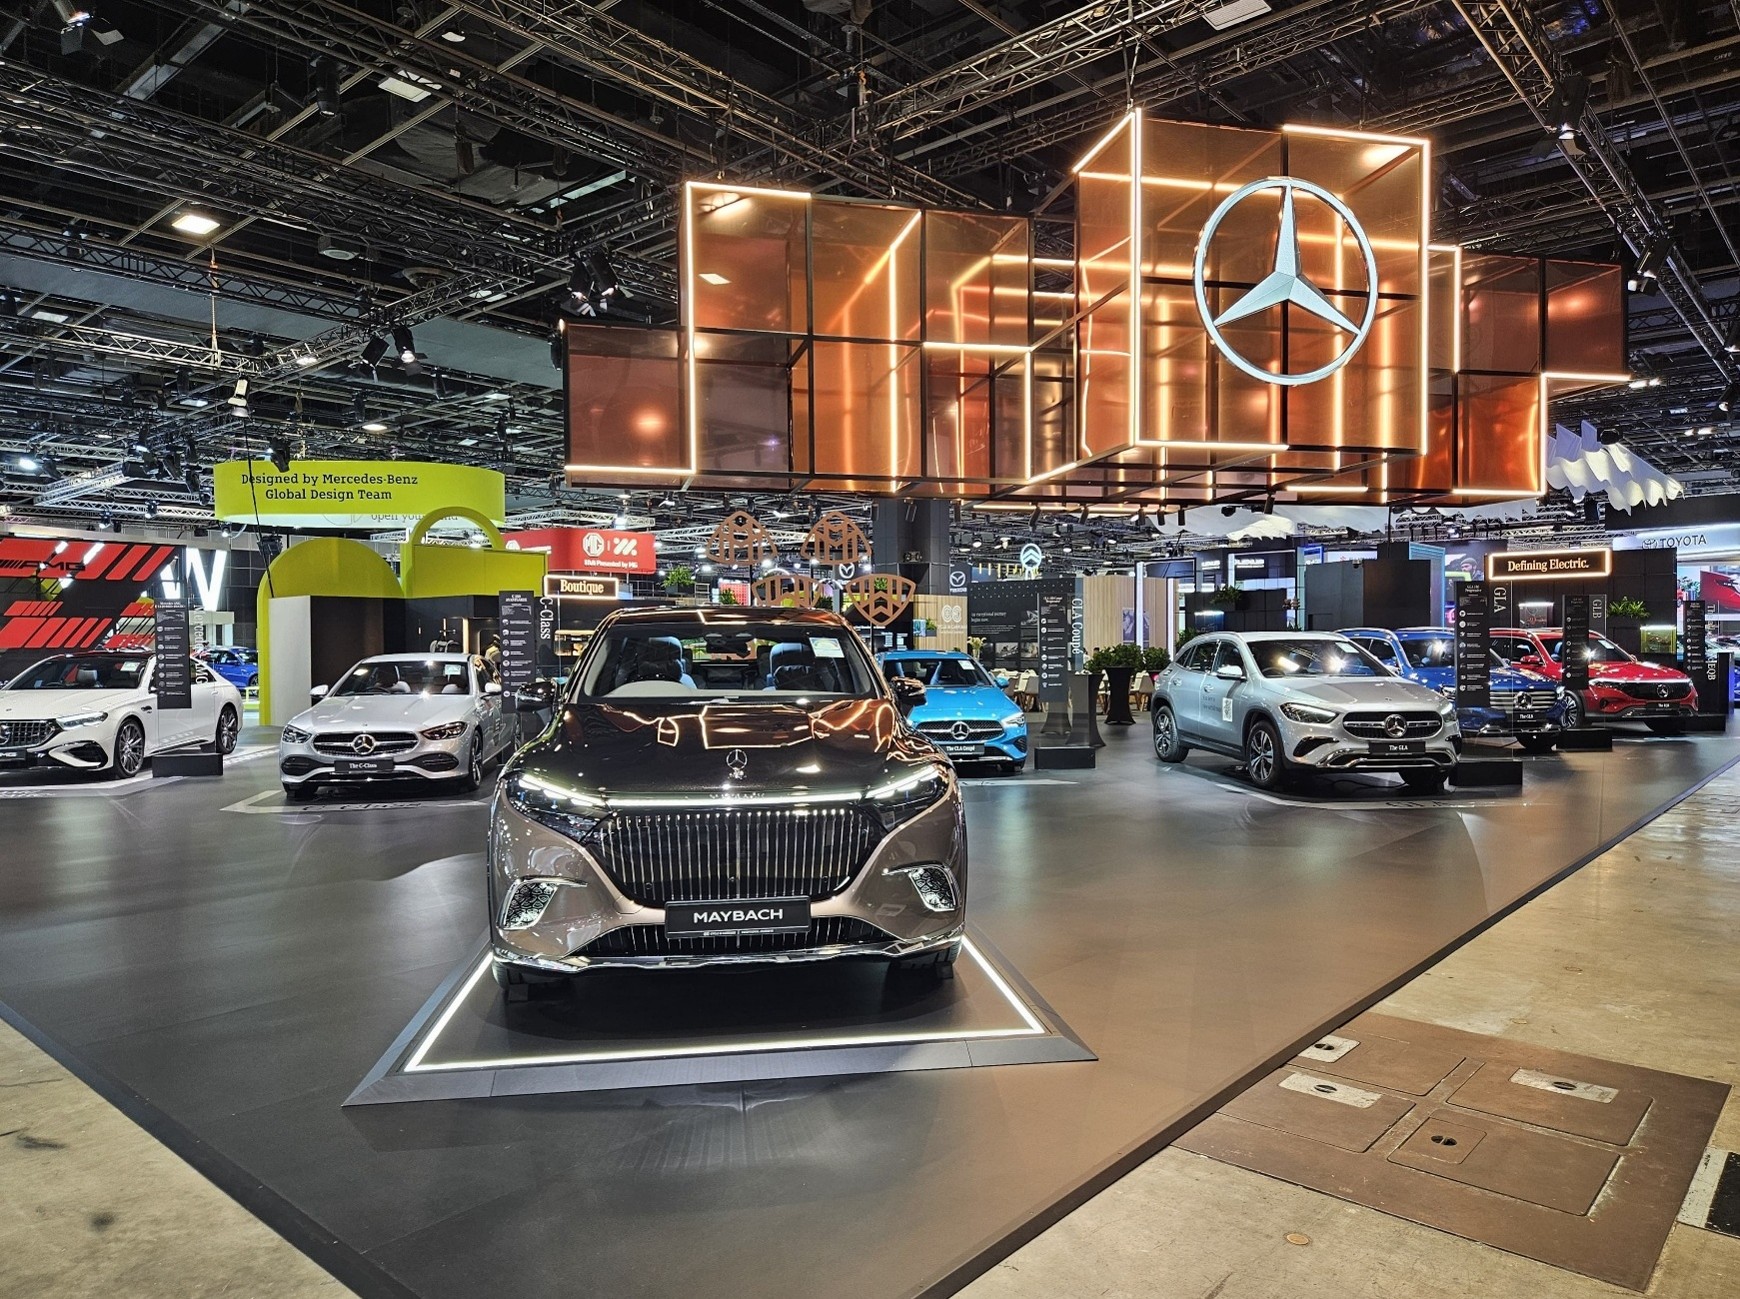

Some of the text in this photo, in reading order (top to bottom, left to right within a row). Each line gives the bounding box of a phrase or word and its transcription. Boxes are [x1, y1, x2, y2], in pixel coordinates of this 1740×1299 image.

[241, 473, 418, 486] Designed by Mercedes-Benz
[265, 488, 392, 502] Global Design Team
[1659, 534, 1707, 549] TOYOTA
[1507, 557, 1590, 573] Defining Electric.
[560, 579, 604, 595] Boutique
[1493, 587, 1507, 613] GLA
[1592, 599, 1603, 619] GLB
[539, 597, 554, 640] C-Class
[1071, 598, 1084, 655] CLA Coupé
[693, 908, 784, 924] MAYBACH
